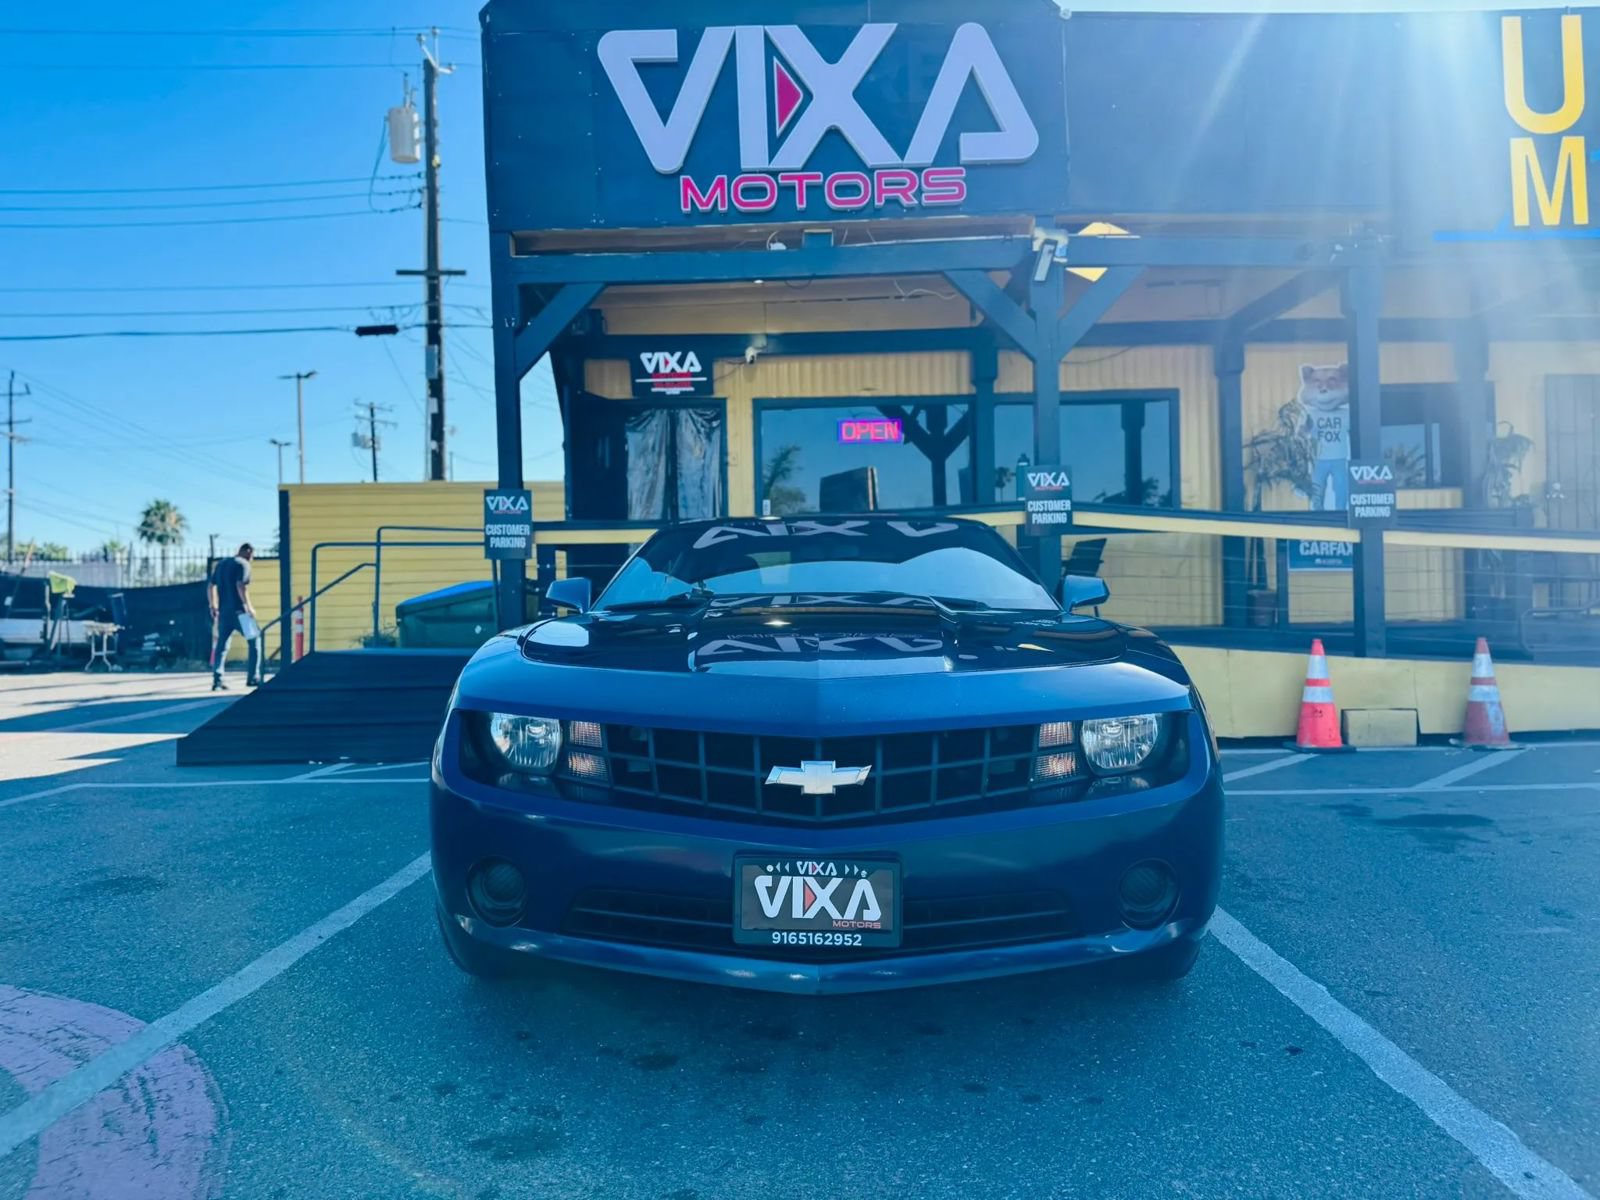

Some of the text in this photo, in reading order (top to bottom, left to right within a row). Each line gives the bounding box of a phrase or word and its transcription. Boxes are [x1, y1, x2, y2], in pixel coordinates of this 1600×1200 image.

[597, 22, 1039, 174] VIXA
[679, 166, 967, 214] MOTORS
[640, 351, 702, 374] VIXA
[1317, 417, 1341, 429] CAR
[842, 422, 900, 441] OPEN
[1317, 430, 1341, 442] FOX
[1027, 471, 1070, 487] VIXA
[1350, 464, 1393, 481] VIXA
[485, 495, 529, 511] VIXA
[1027, 499, 1071, 512] CUSTOMER
[1350, 493, 1394, 505] CUSTOMER
[1032, 512, 1067, 525] PARKING
[1354, 506, 1391, 518] PARKING
[485, 524, 530, 536] CUSTOMER
[490, 536, 526, 549] PARKING
[796, 861, 837, 876] VIXA
[754, 875, 882, 921] VIXA
[832, 919, 881, 929] MOTORS
[771, 931, 862, 946] 9165162952
